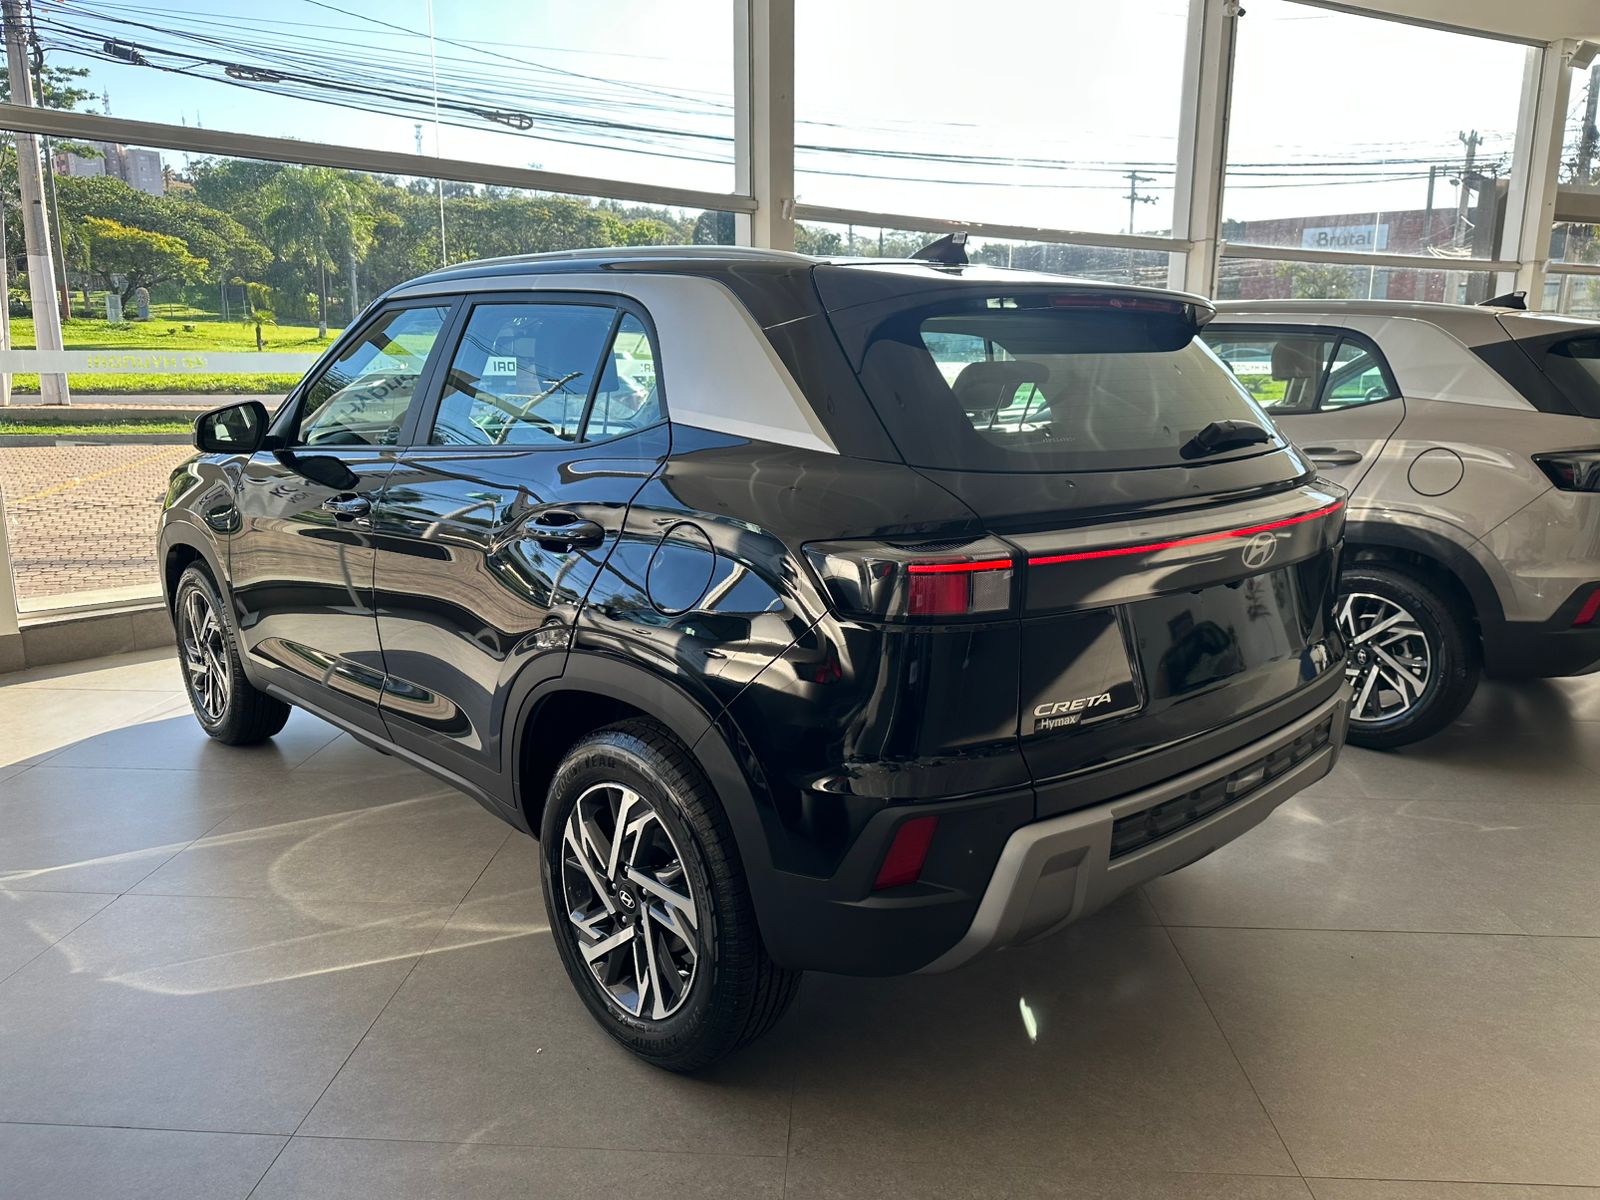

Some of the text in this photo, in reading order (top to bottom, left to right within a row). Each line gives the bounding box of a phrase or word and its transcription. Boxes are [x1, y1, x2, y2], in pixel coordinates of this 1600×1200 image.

[1317, 231, 1371, 247] Brutal
[1033, 692, 1112, 716] CRETA
[1041, 715, 1076, 730] Hymax
